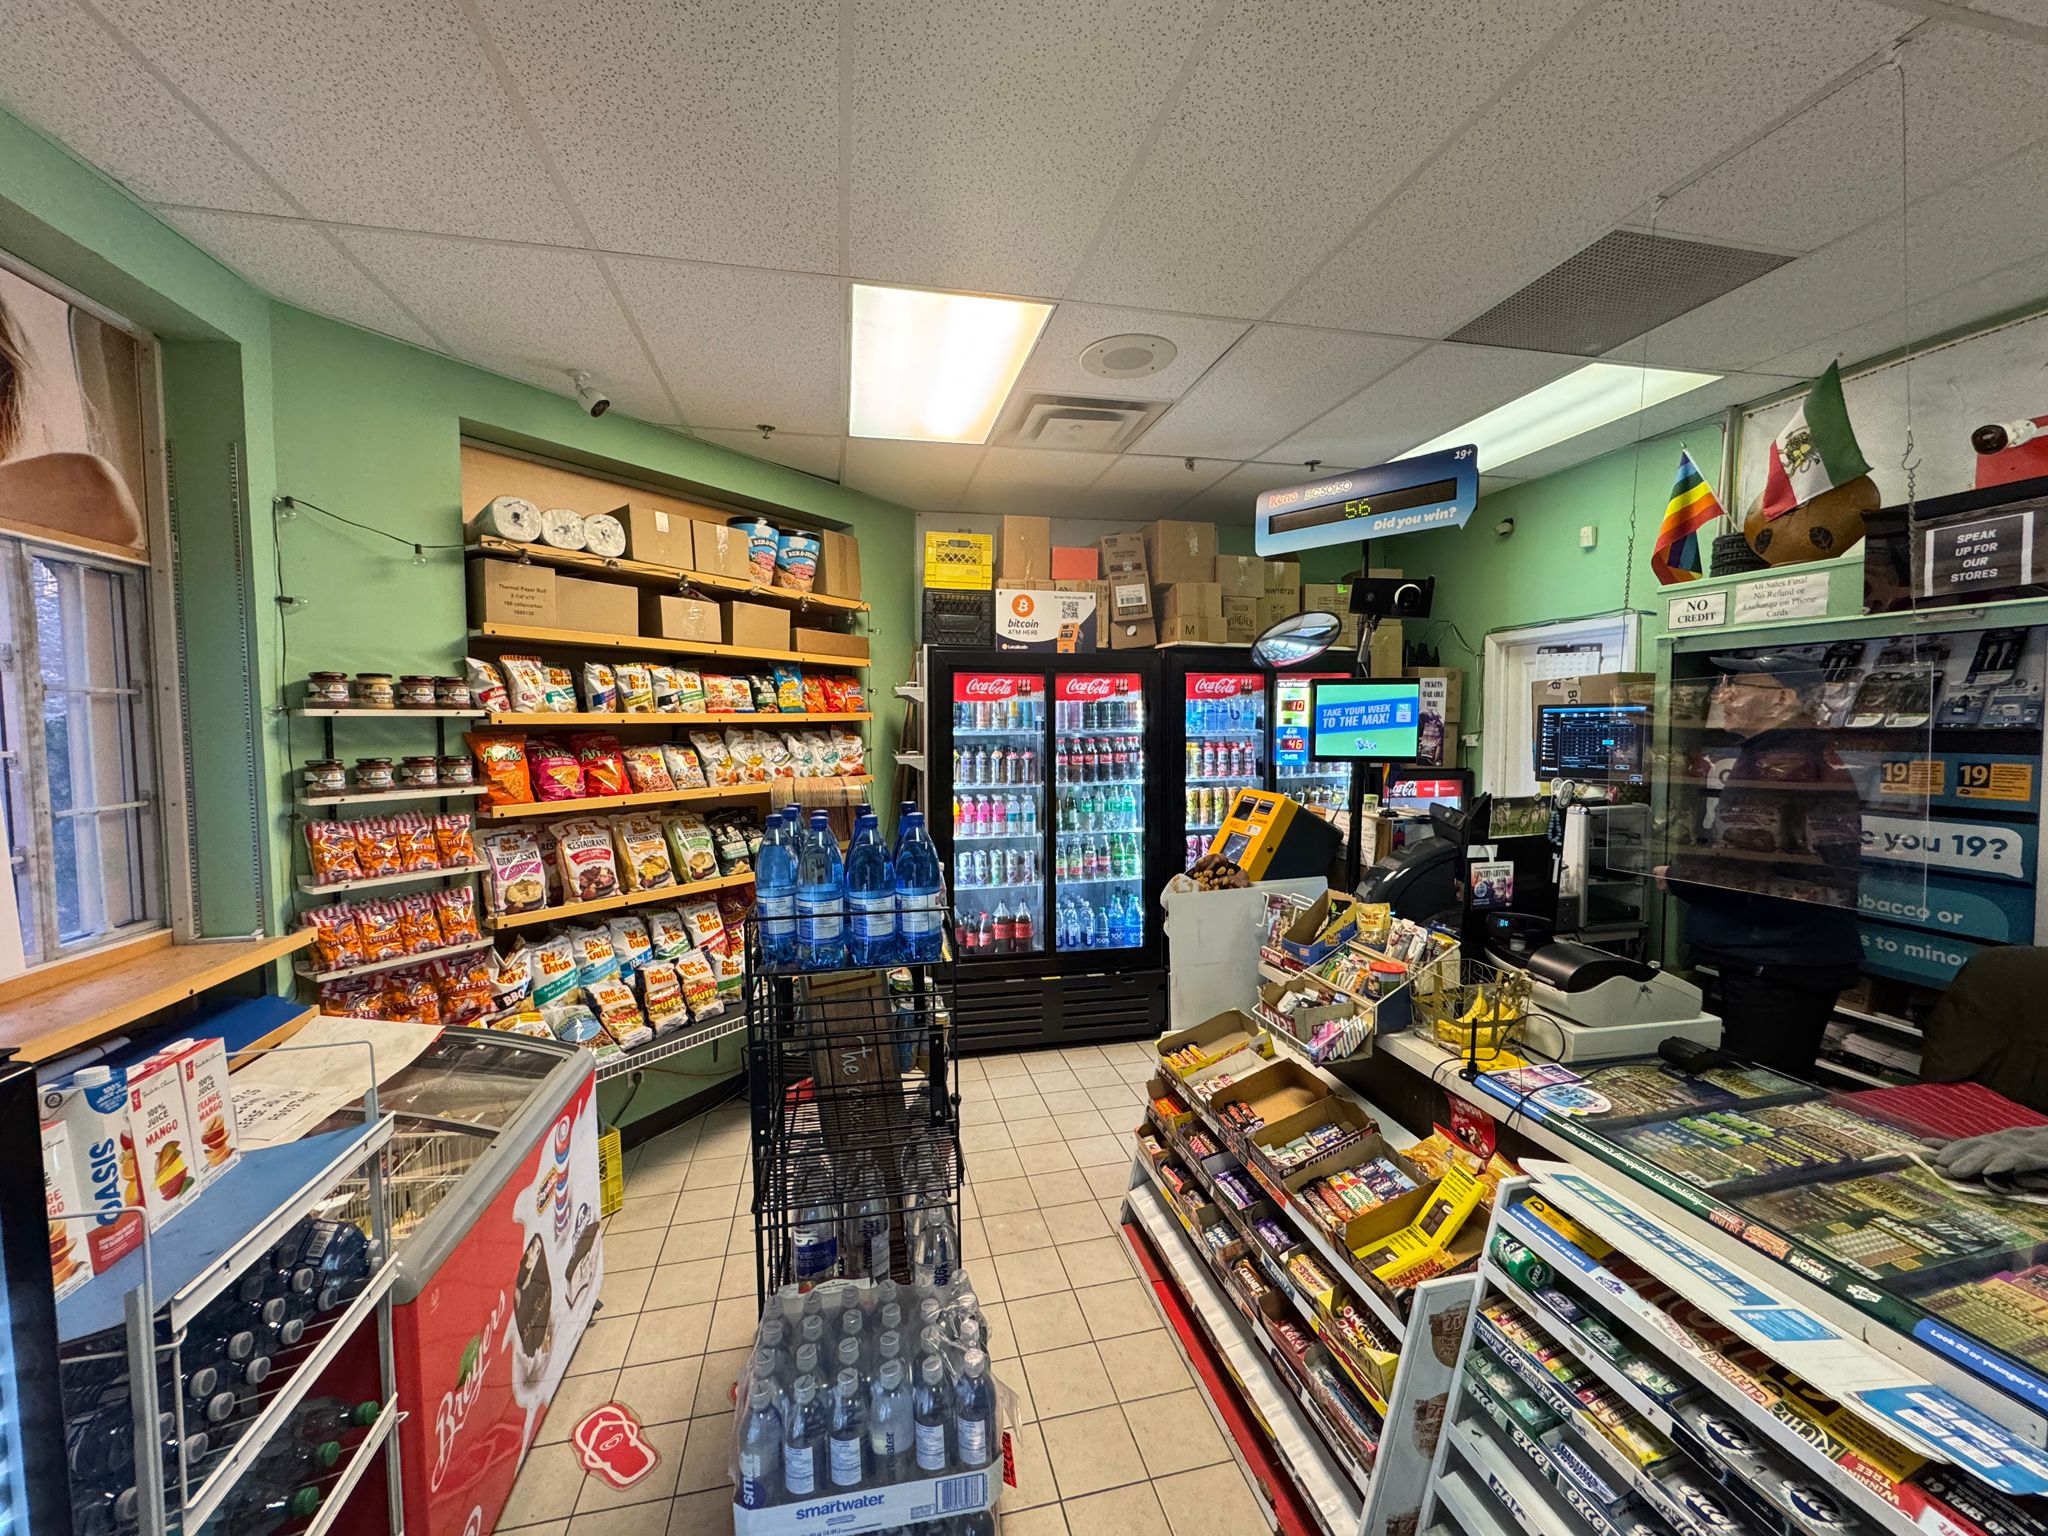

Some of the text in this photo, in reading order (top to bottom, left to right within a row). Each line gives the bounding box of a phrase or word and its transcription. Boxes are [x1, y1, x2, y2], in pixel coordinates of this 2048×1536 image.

[1454, 449, 1473, 459] 19+
[1269, 491, 1298, 508] Keno
[1344, 498, 1371, 518] 56
[1373, 507, 1457, 530] Did you win?
[1957, 528, 1997, 544] SPEAK
[1955, 541, 1998, 556] UP FOR
[1962, 556, 1988, 568] OUR
[1752, 576, 1808, 590] All Sales Final
[1950, 567, 1998, 583] STORES
[1767, 588, 1794, 598] Refund
[1686, 599, 1708, 612] NO
[1742, 600, 1778, 611] Exchange
[1791, 596, 1817, 605] Phone
[1677, 611, 1716, 624] CREDIT
[1766, 609, 1788, 618] Cards
[1008, 619, 1039, 628] bitcoin
[966, 678, 1012, 696] Coca-Cola
[1065, 678, 1110, 696] Coca-Cola
[1194, 678, 1237, 695] Coca-Cola
[1292, 700, 1304, 711] 10
[1323, 709, 1342, 717] TAKE
[1344, 706, 1366, 715] YOUR
[1368, 704, 1391, 713] WEEK
[1323, 713, 1390, 728] TO THE MAX!
[1288, 740, 1303, 749] 46
[1883, 762, 1906, 782] 19
[1959, 764, 1989, 786] 19
[1885, 830, 2009, 860] you 19?
[697, 912, 710, 923] Old
[1858, 894, 1963, 925] bacco or
[700, 921, 721, 933] Dutch
[629, 936, 649, 949] Dutch
[1875, 933, 1968, 966] to mino
[540, 952, 556, 964] Old
[679, 961, 696, 972] Old
[722, 960, 735, 968] Old
[543, 960, 572, 975] Dutch
[721, 967, 741, 977] Dutch
[650, 970, 676, 985] Dutch
[503, 988, 526, 1007] BBQ
[600, 988, 617, 999] Old
[653, 996, 683, 1013] PUFFS
[102, 1081, 122, 1095] 100%
[198, 1080, 216, 1097] JUICE
[199, 1075, 213, 1087] 100%
[197, 1090, 221, 1112] ORANGE
[147, 1102, 167, 1118] 100%
[147, 1109, 169, 1128] JUICE
[199, 1100, 223, 1123] MANGO
[145, 1119, 178, 1148] MANGO
[1561, 1121, 1580, 1136] Gifts
[1594, 1137, 1615, 1152] won't
[1613, 1148, 1655, 1178] disappoint
[1654, 1171, 1671, 1187] this
[1670, 1182, 1704, 1206] holiday
[89, 1138, 121, 1227] OASIS
[1572, 1255, 1586, 1268] Look
[1789, 1255, 1834, 1282] MONEY
[1387, 1258, 1436, 1287] TOBLERONE
[1930, 1329, 1956, 1347] Look
[1955, 1343, 1970, 1354] 25
[1968, 1350, 1983, 1361] or
[1982, 1358, 2036, 1390] younger?
[1475, 1320, 1571, 1417] Dentyne ice Dentyne ice
[430, 1288, 506, 1494] Breyers
[1729, 1371, 1771, 1405] GIFT
[1466, 1382, 1501, 1419] excel
[1512, 1429, 1550, 1473] excel
[1854, 1460, 1895, 1491] TREE
[1923, 1476, 1945, 1494] 19
[1945, 1493, 1985, 1521] YEARS
[795, 1494, 885, 1521] smartwater
[1566, 1488, 1610, 1535] excel
